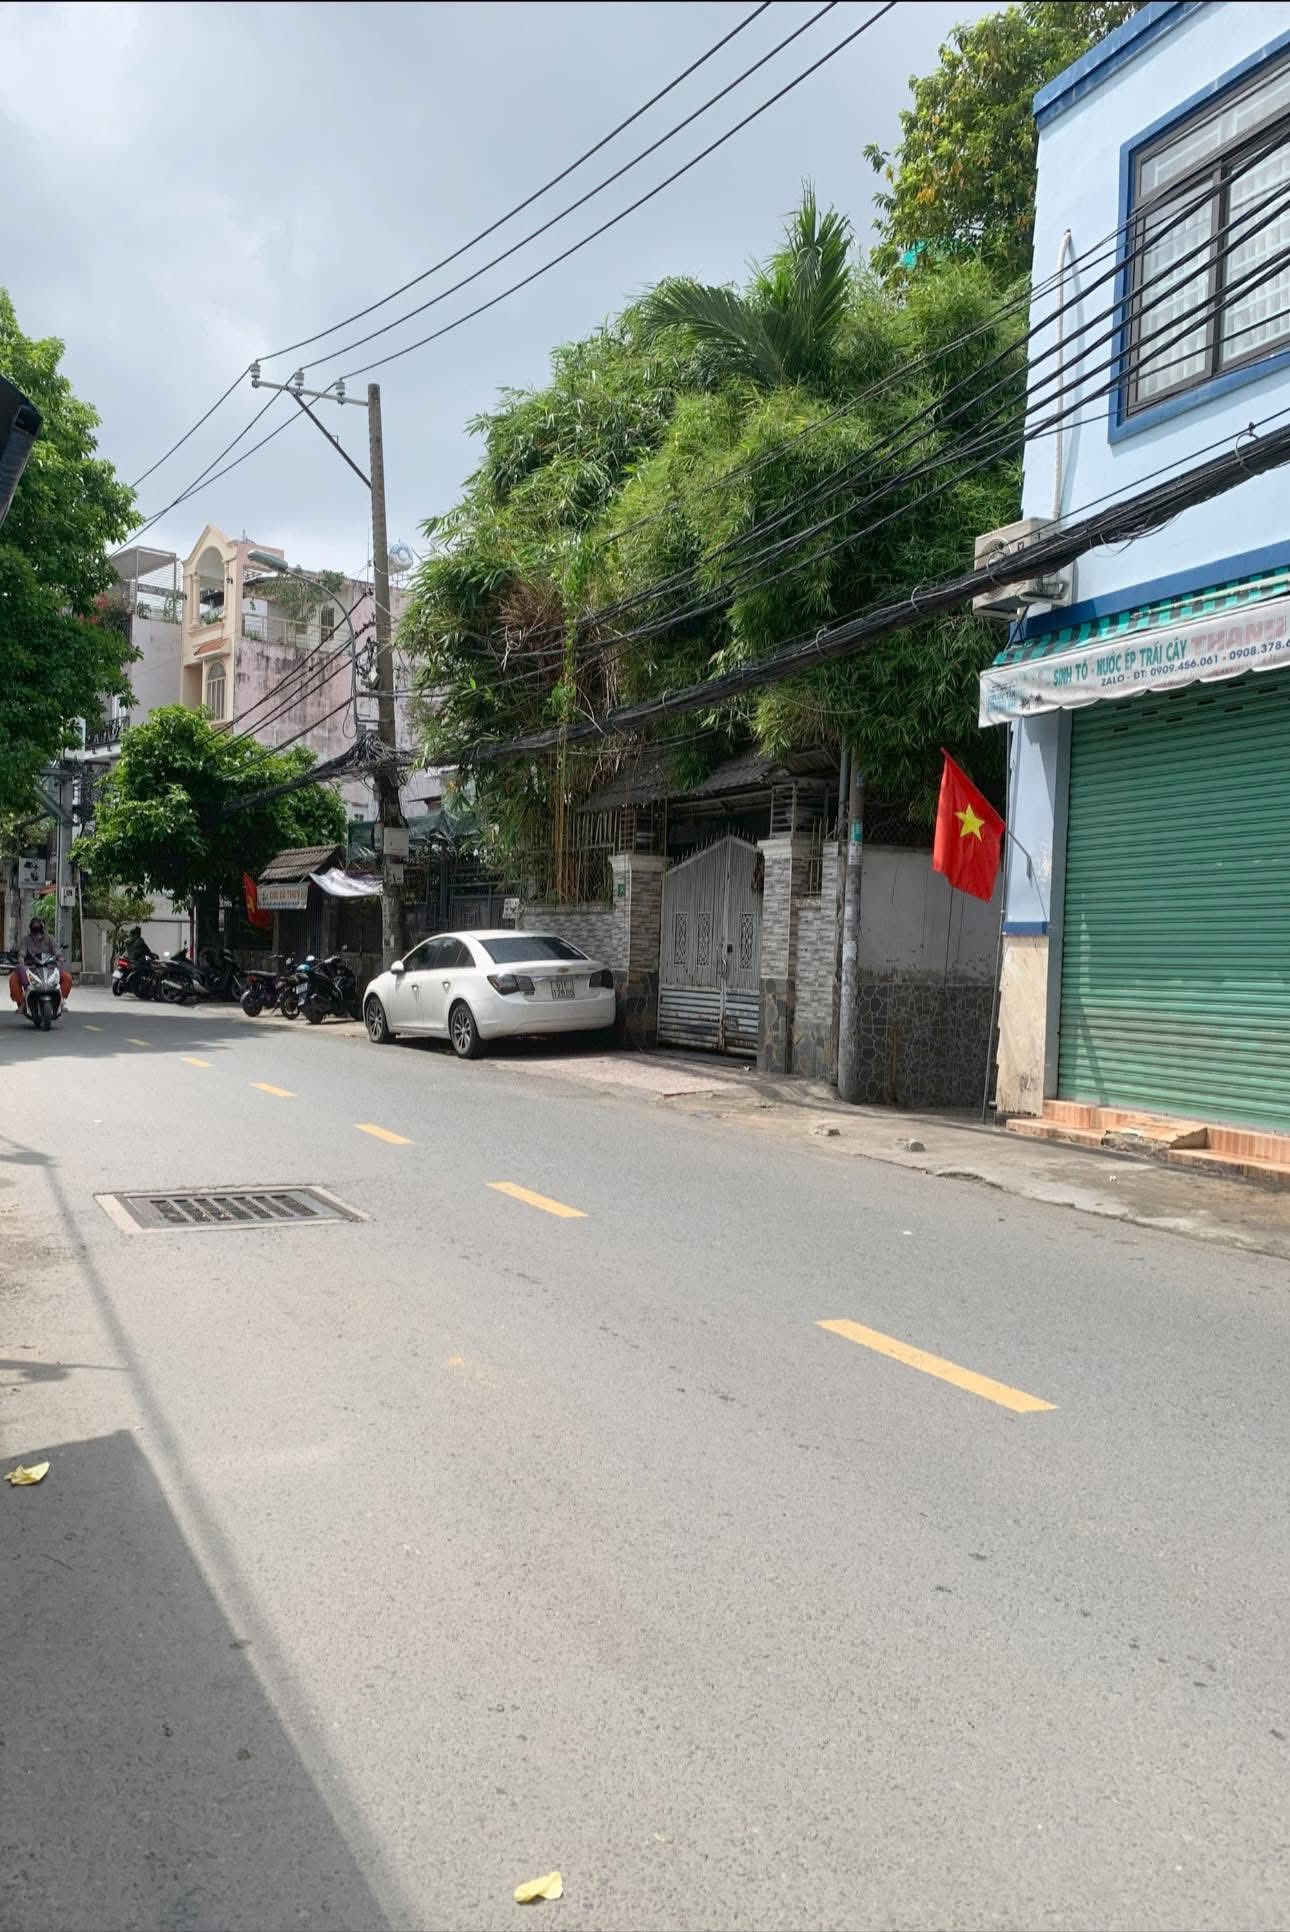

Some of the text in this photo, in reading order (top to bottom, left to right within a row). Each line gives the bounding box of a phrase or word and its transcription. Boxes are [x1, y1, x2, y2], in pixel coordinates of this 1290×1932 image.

[1053, 664, 1072, 687] SINH
[1124, 647, 1136, 670] ÉP
[1139, 641, 1162, 668] TRÁI
[1166, 636, 1187, 662] CÂY
[1101, 674, 1125, 687] ZALO
[1133, 669, 1148, 681] ĐT:
[1150, 654, 1218, 677] 0909.456.061
